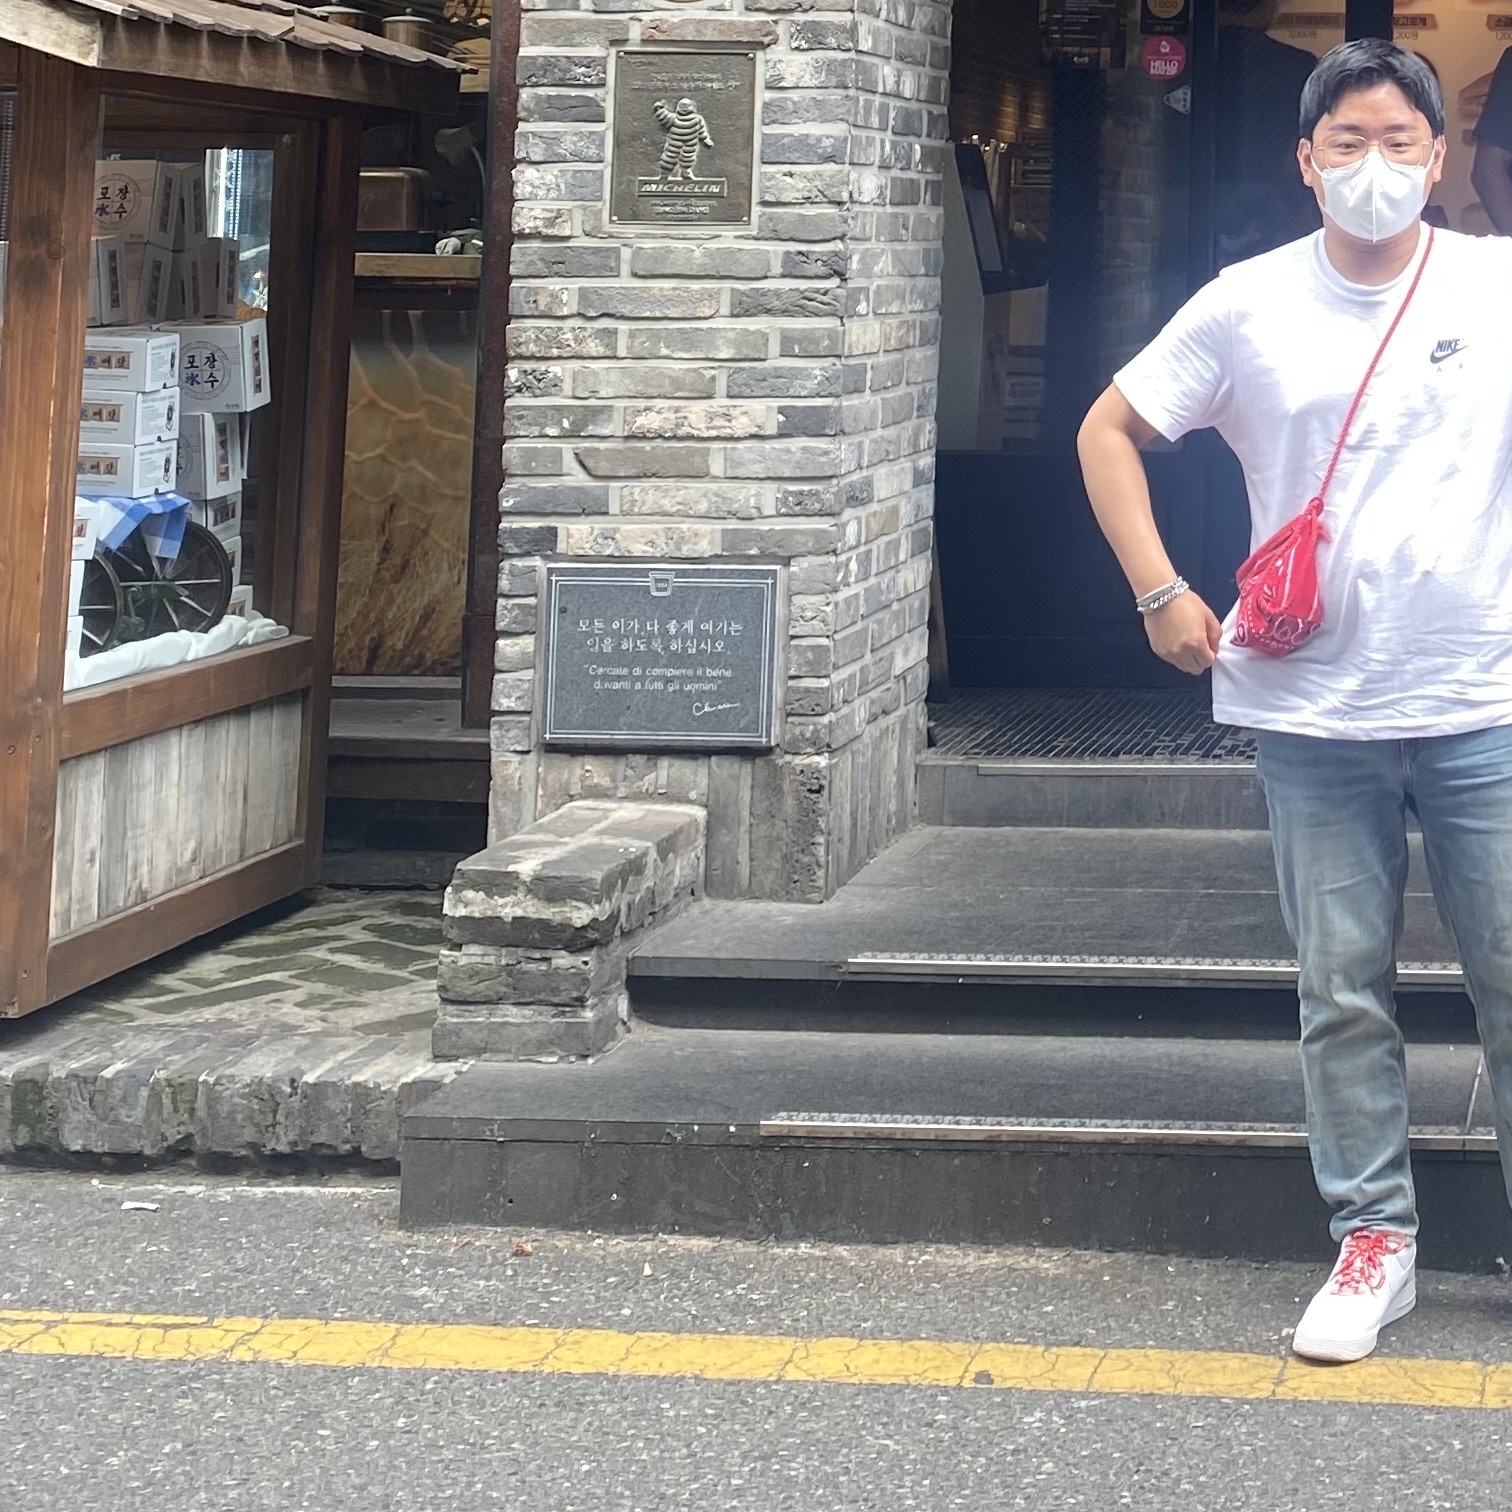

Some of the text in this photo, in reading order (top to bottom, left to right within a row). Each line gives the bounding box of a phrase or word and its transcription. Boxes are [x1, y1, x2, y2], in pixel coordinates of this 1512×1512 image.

[639, 182, 721, 194] MICHELIN
[1434, 338, 1461, 354] NIKE
[577, 618, 605, 634] 모든
[646, 618, 660, 635] 다
[665, 619, 694, 635] 좋게
[700, 619, 744, 636] 여기는
[632, 665, 642, 676] di
[645, 666, 693, 679] compiere
